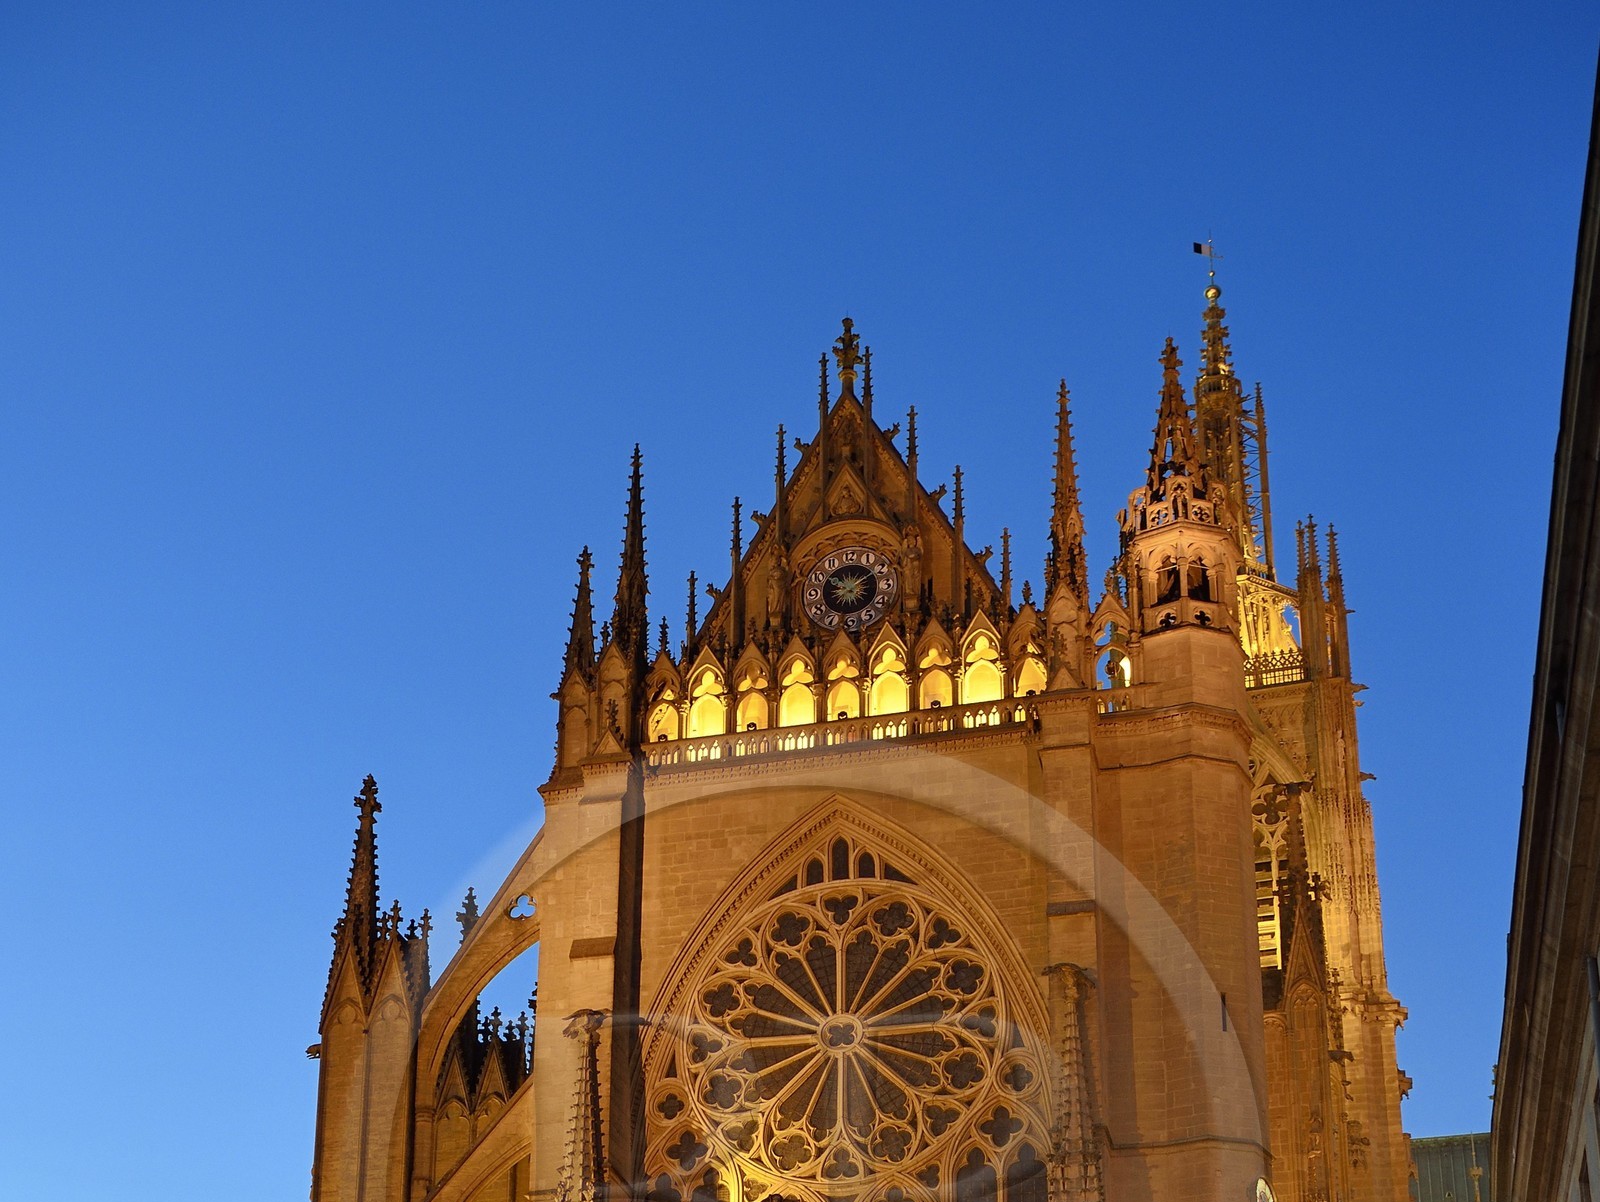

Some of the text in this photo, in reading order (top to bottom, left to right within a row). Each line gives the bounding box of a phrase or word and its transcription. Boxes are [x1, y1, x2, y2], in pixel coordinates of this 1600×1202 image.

[845, 551, 855, 562] 12
[865, 553, 871, 565] 1
[829, 557, 836, 568] 11
[876, 563, 887, 575] 2
[814, 572, 825, 583] 10
[882, 579, 892, 590] 3
[808, 588, 819, 599] 9
[876, 595, 886, 606] 4
[813, 604, 824, 615] 8
[864, 609, 873, 621] 5
[827, 614, 836, 626] 7
[846, 617, 856, 628] 6
